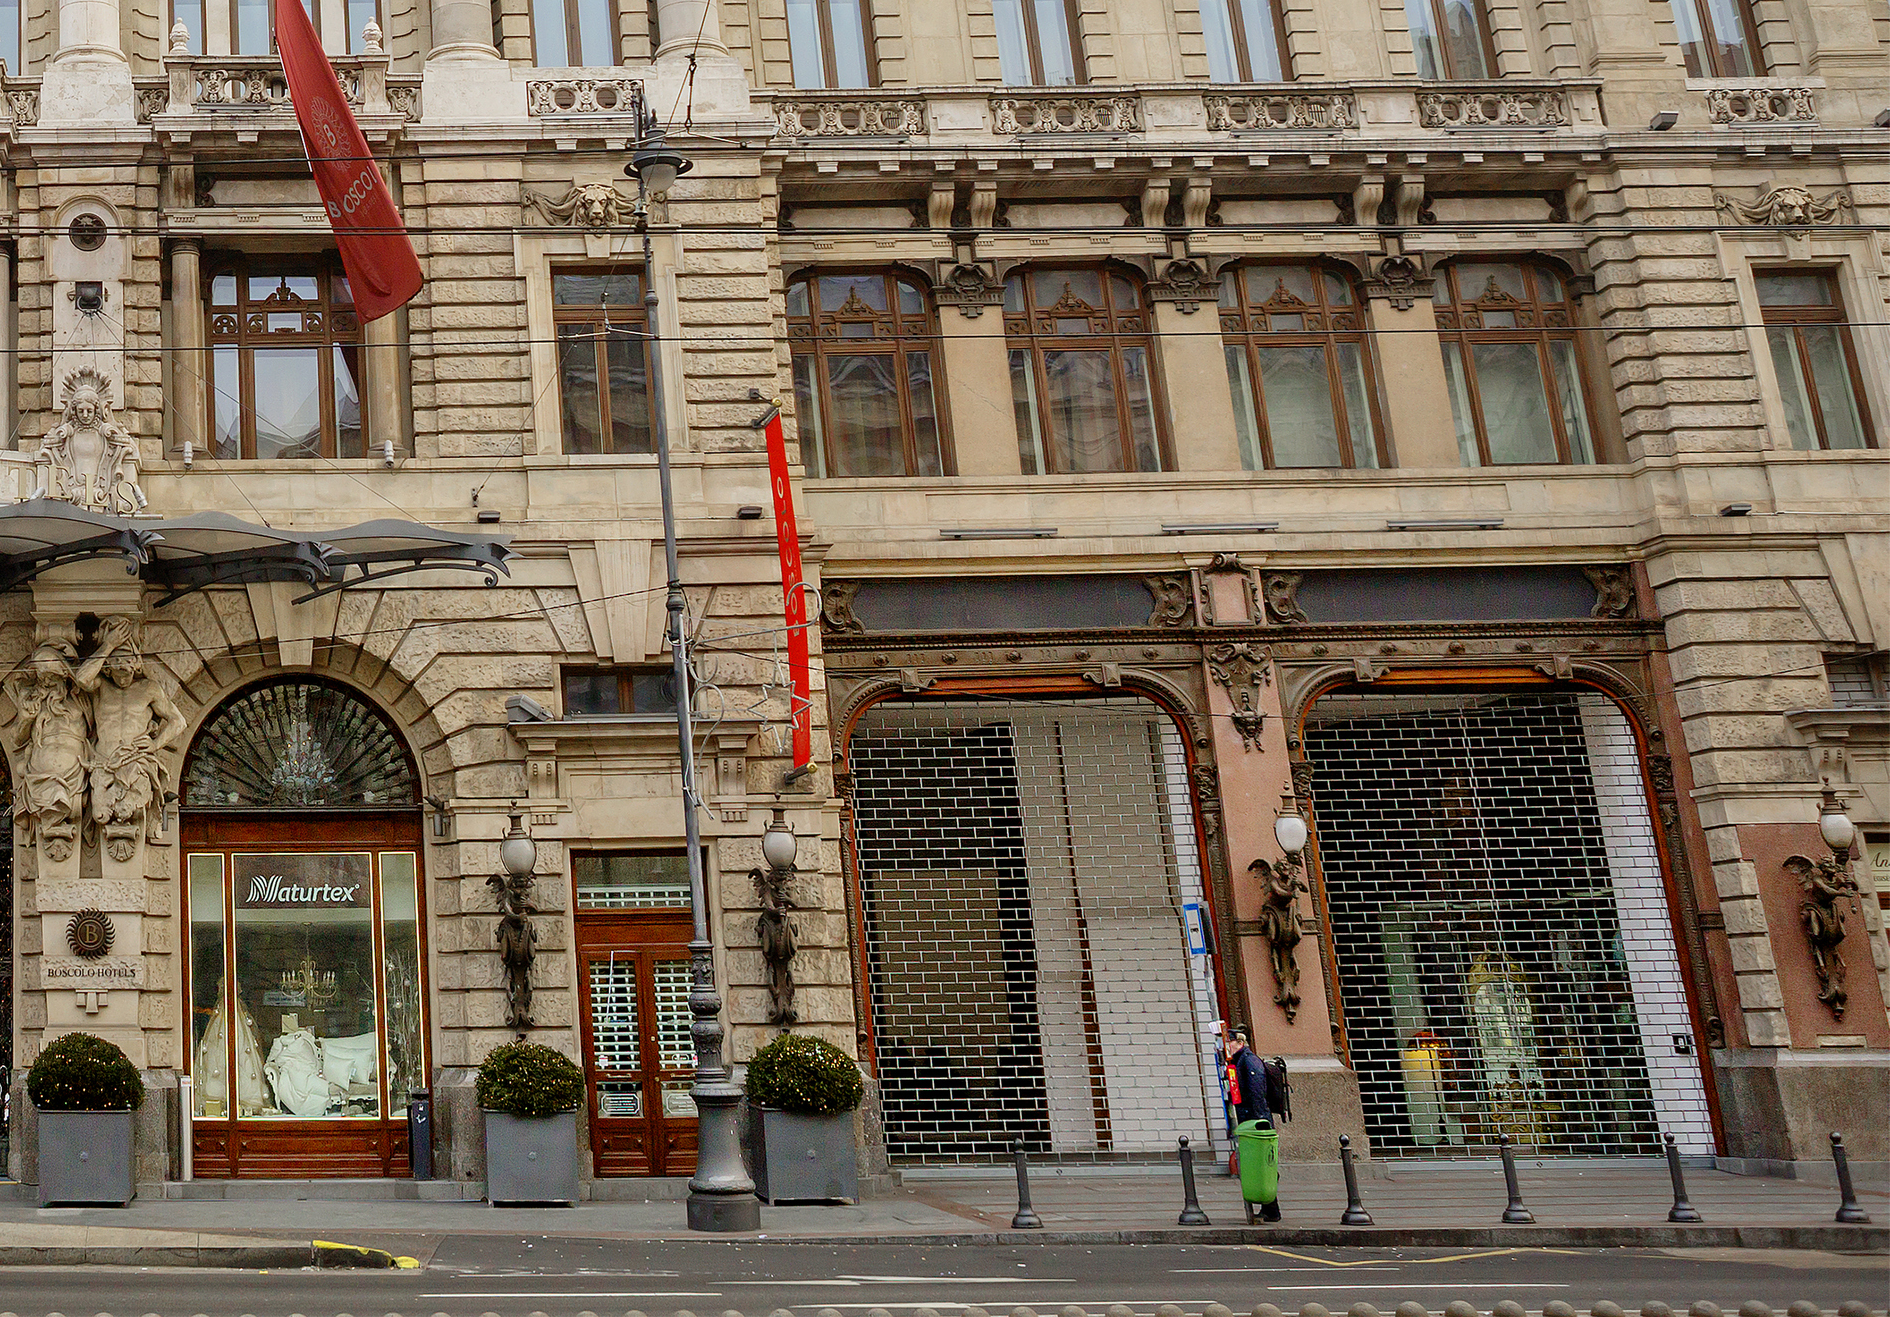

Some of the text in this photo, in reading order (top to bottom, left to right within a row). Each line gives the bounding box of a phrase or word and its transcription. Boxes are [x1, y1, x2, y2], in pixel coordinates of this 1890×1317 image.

[84, 924, 99, 944] B
[47, 968, 136, 978] BOSCOLO HOTELS
